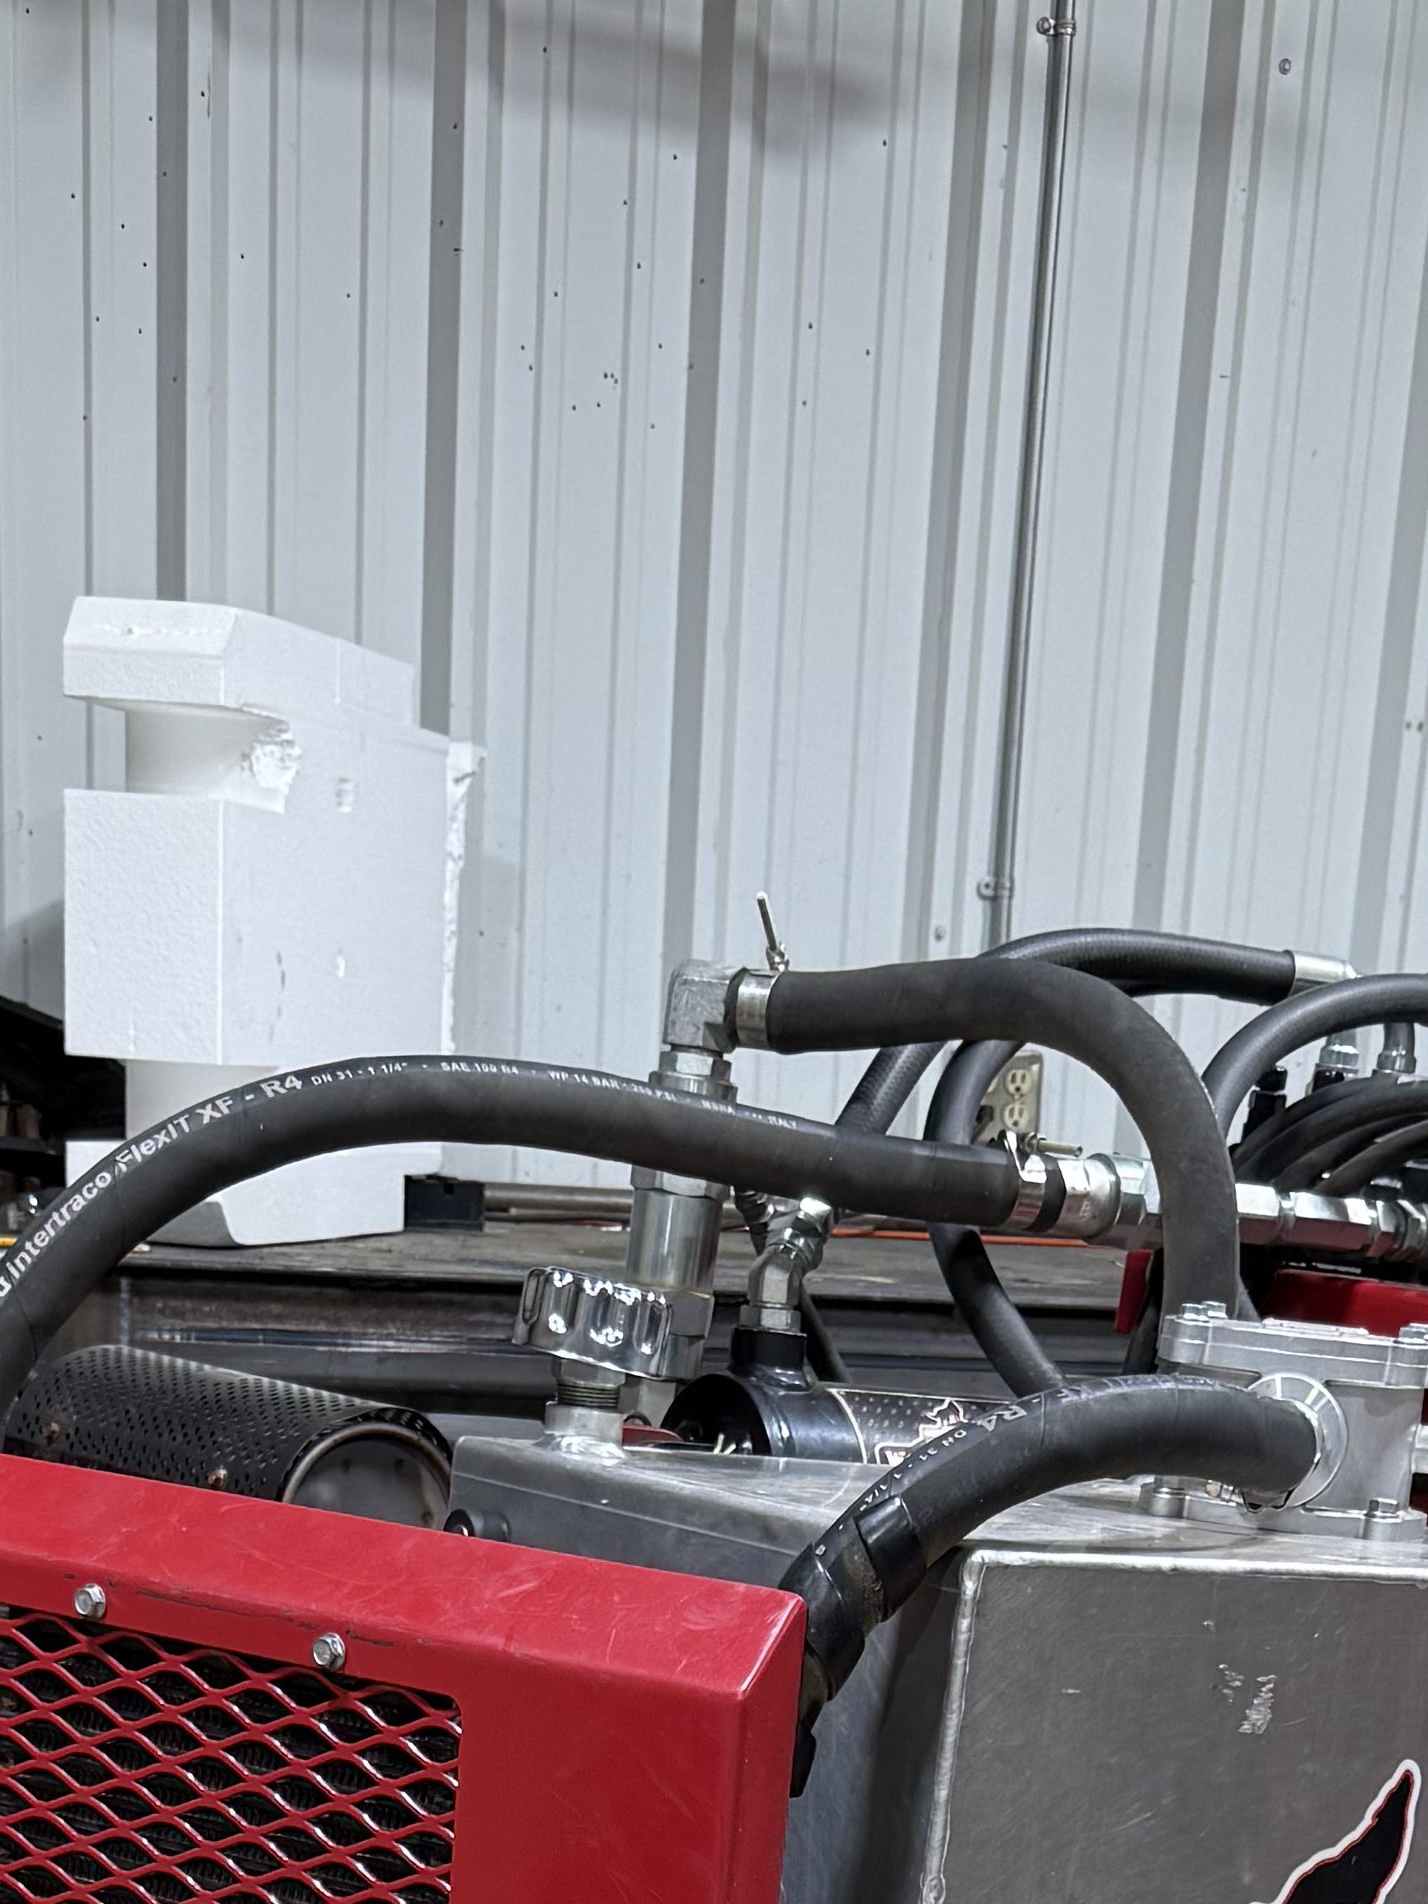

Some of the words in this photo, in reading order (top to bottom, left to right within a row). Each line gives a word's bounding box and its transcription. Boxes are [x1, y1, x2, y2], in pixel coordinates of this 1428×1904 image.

[440, 1062, 471, 1073] SAE
[7, 1171, 113, 1280] intertraco
[196, 1096, 235, 1124] XF
[260, 1074, 303, 1098] R4
[311, 1071, 333, 1085] DN
[974, 1403, 1028, 1433] R4
